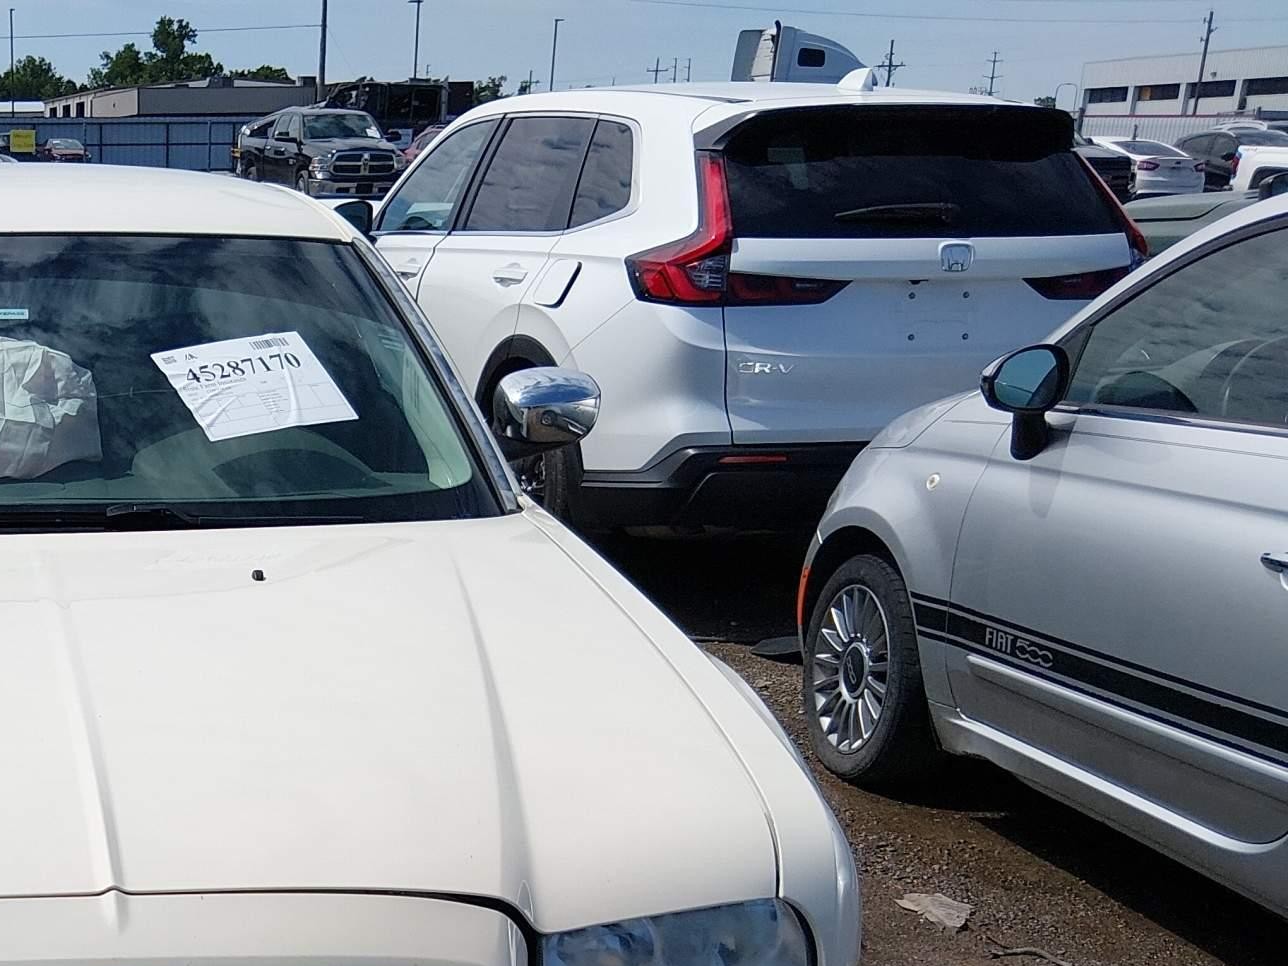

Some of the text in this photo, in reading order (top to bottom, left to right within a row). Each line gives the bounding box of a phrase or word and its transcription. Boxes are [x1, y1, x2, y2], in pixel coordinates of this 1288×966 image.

[186, 352, 302, 384] 45287170
[738, 362, 794, 375] CR-V
[985, 627, 1054, 668] FIAT 500
